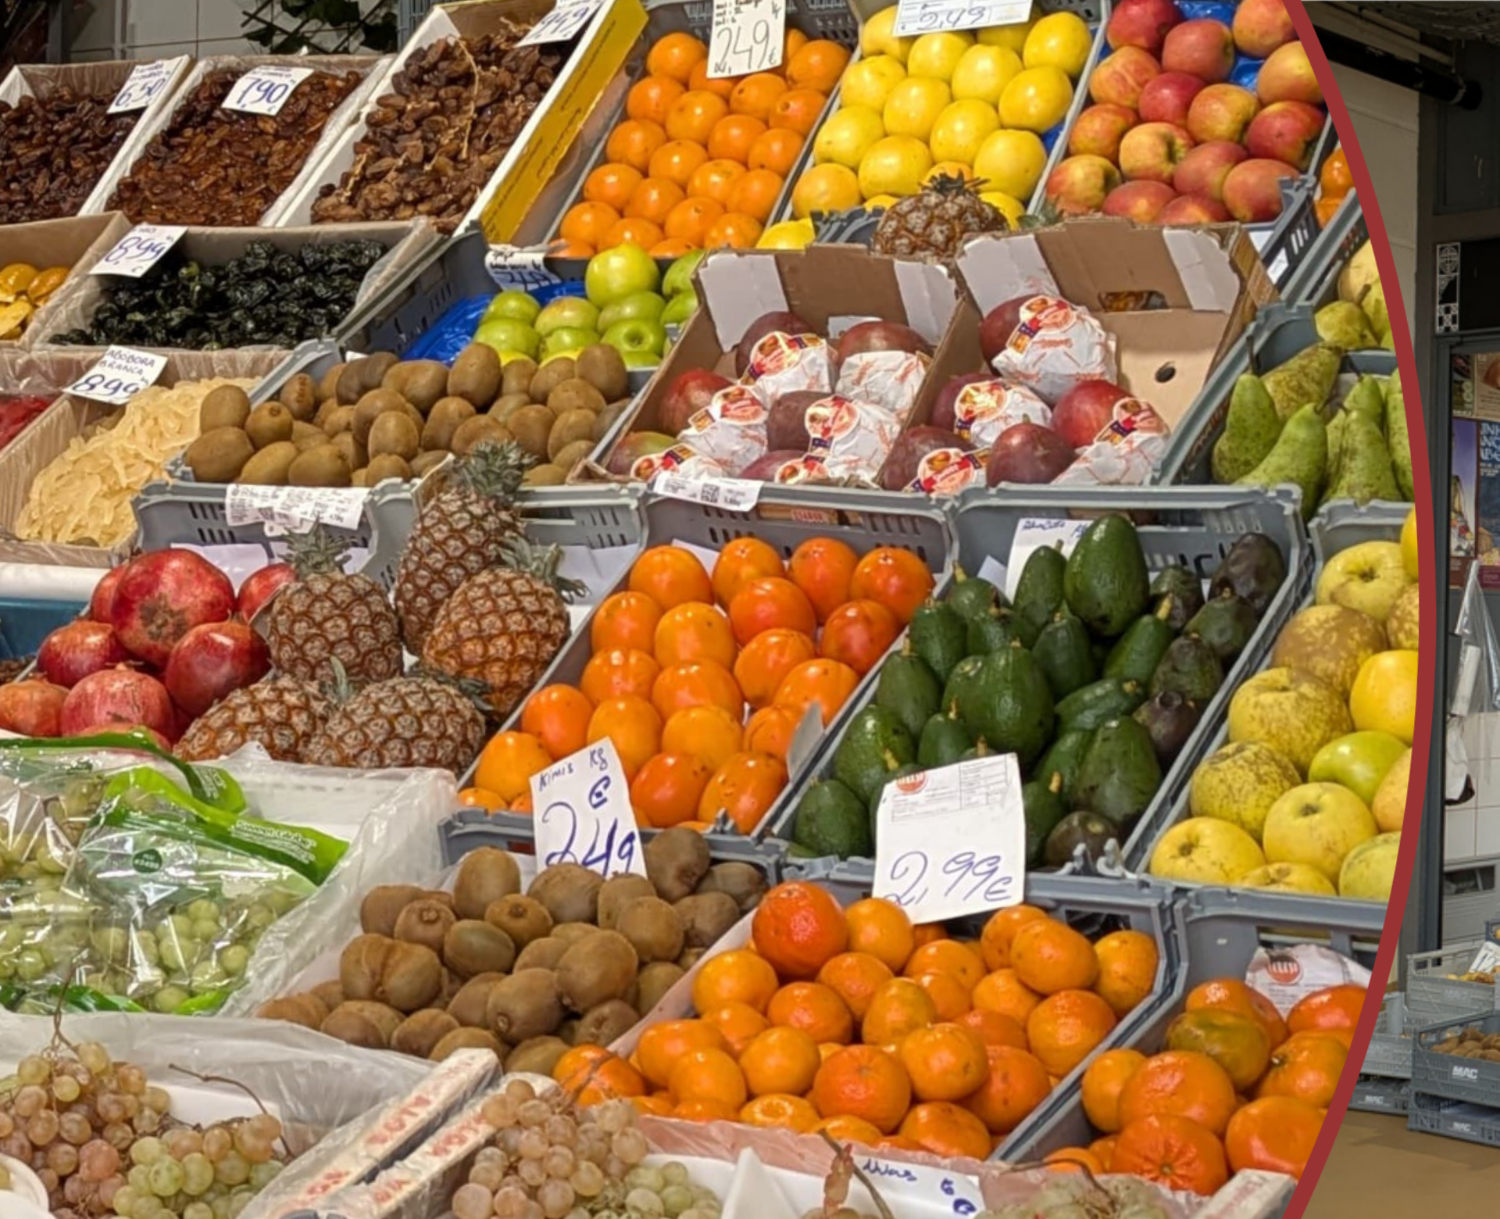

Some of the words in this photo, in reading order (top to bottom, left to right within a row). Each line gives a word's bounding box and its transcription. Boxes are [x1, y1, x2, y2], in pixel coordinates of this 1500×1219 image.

[916, 7, 986, 31] 2,49
[107, 349, 156, 368] ABÓBORA
[883, 850, 998, 905] 2,99
[1452, 1065, 1479, 1080] MAC
